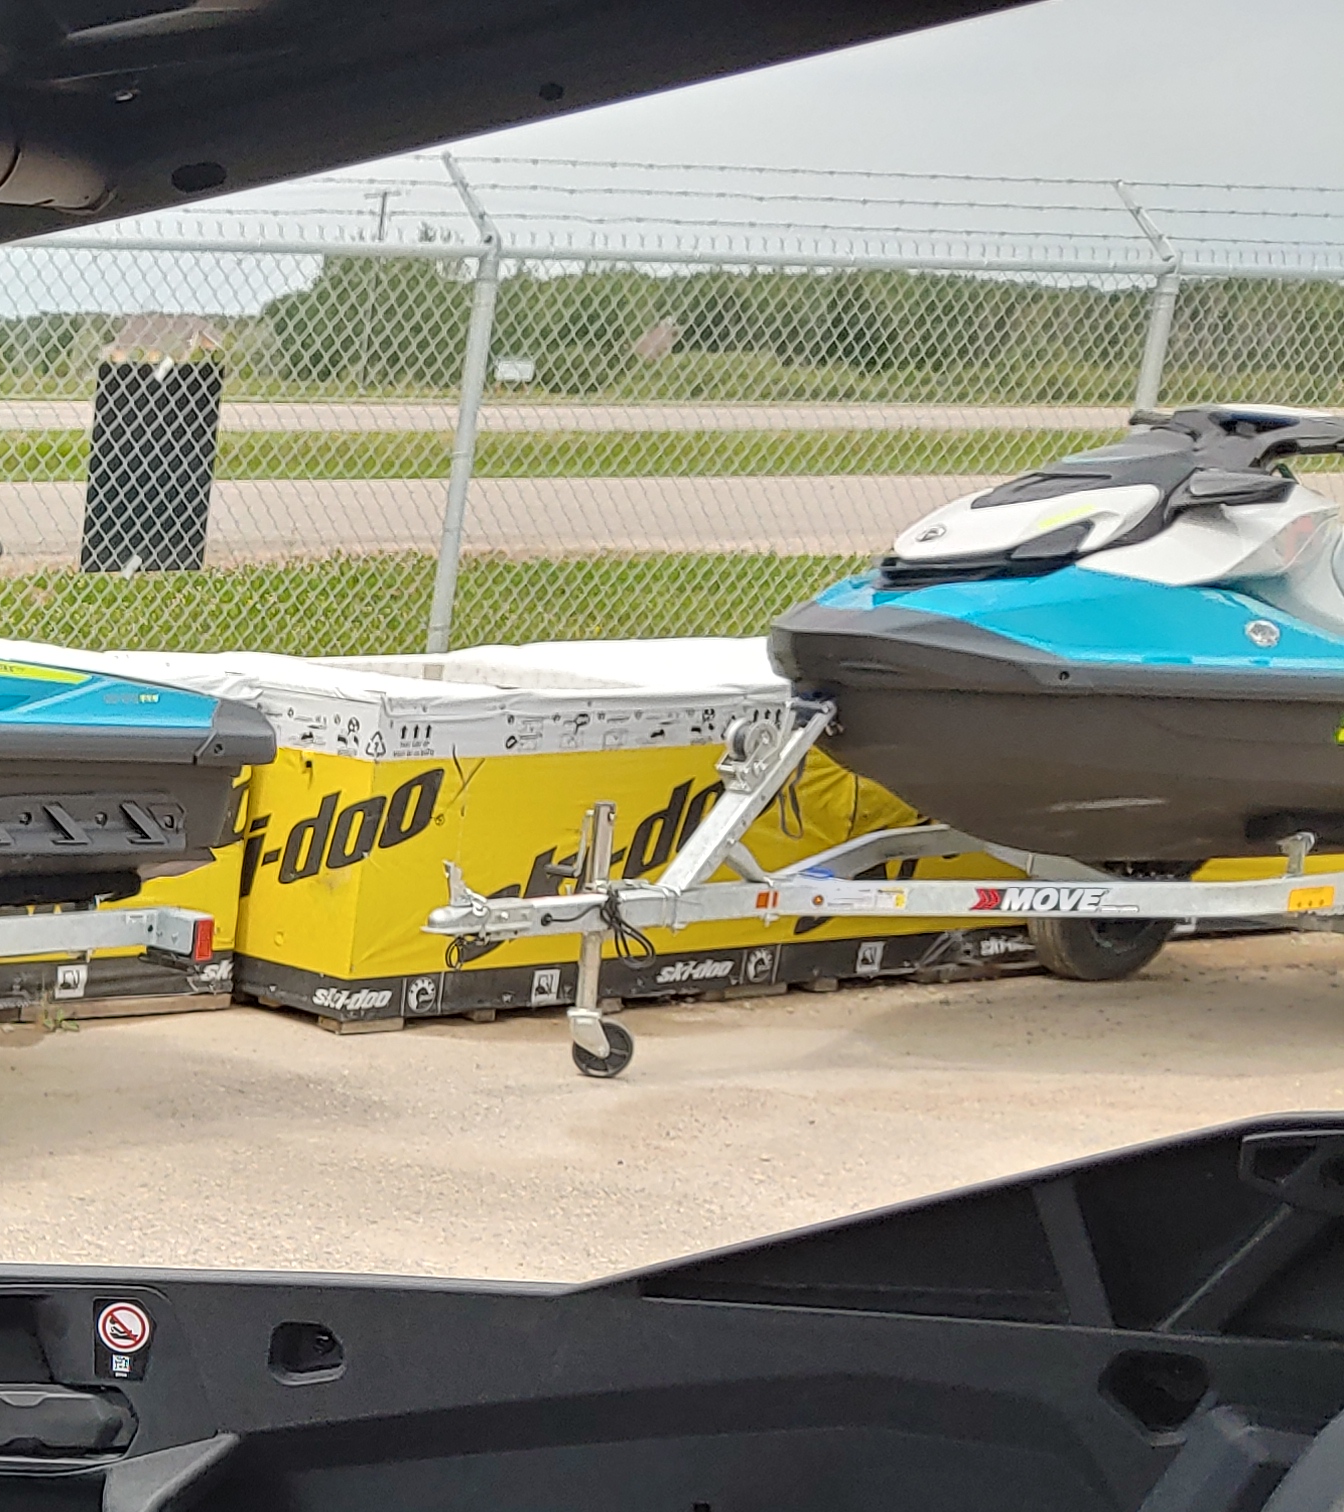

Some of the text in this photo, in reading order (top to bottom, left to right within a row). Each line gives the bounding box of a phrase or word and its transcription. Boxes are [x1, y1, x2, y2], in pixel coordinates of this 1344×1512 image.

[240, 769, 444, 899] i-doo
[1000, 887, 1103, 912] MOVE
[655, 957, 736, 984] ski-doo
[312, 987, 393, 1012] ski-doo
